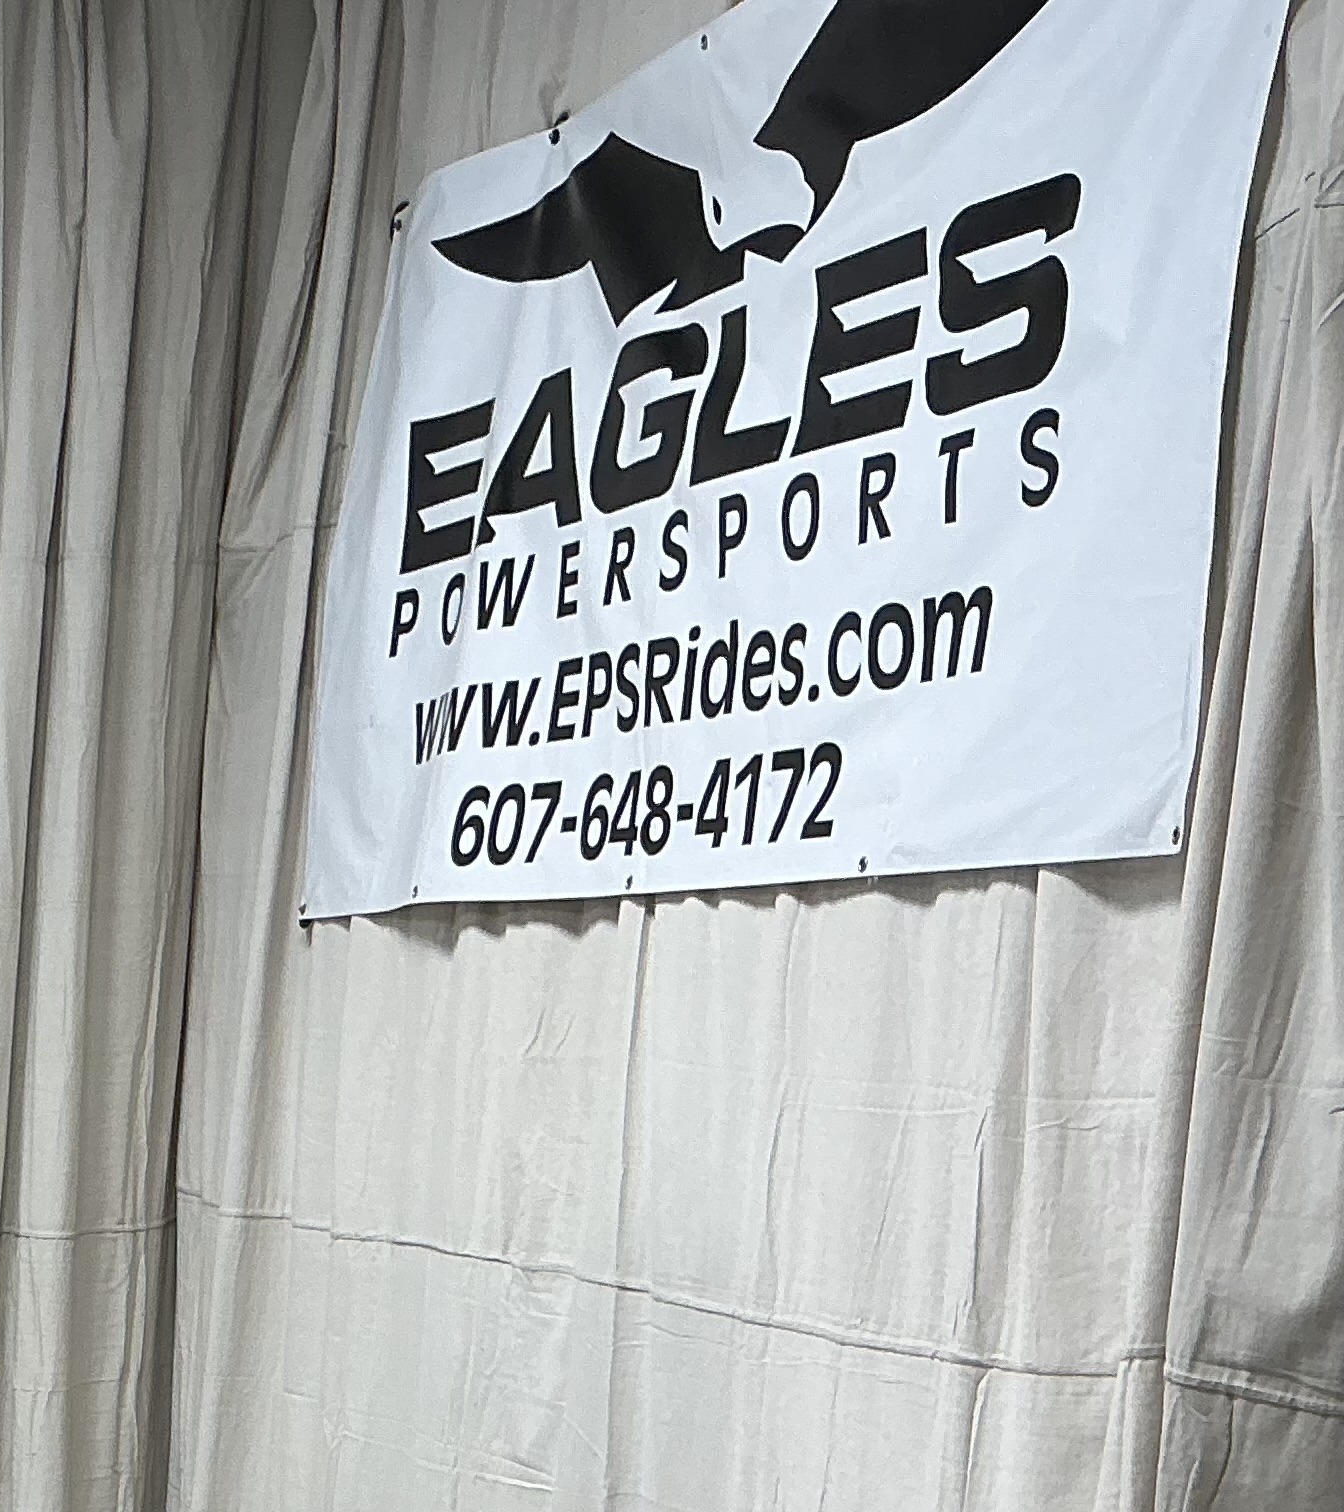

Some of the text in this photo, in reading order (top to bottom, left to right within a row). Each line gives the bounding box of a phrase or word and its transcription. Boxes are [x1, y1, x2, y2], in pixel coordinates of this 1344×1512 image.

[398, 172, 1082, 577] EAGLES
[388, 407, 1060, 658] POWERSPORTS
[414, 585, 994, 766] www.EPSRides.com
[450, 742, 844, 868] 607-648-4172
